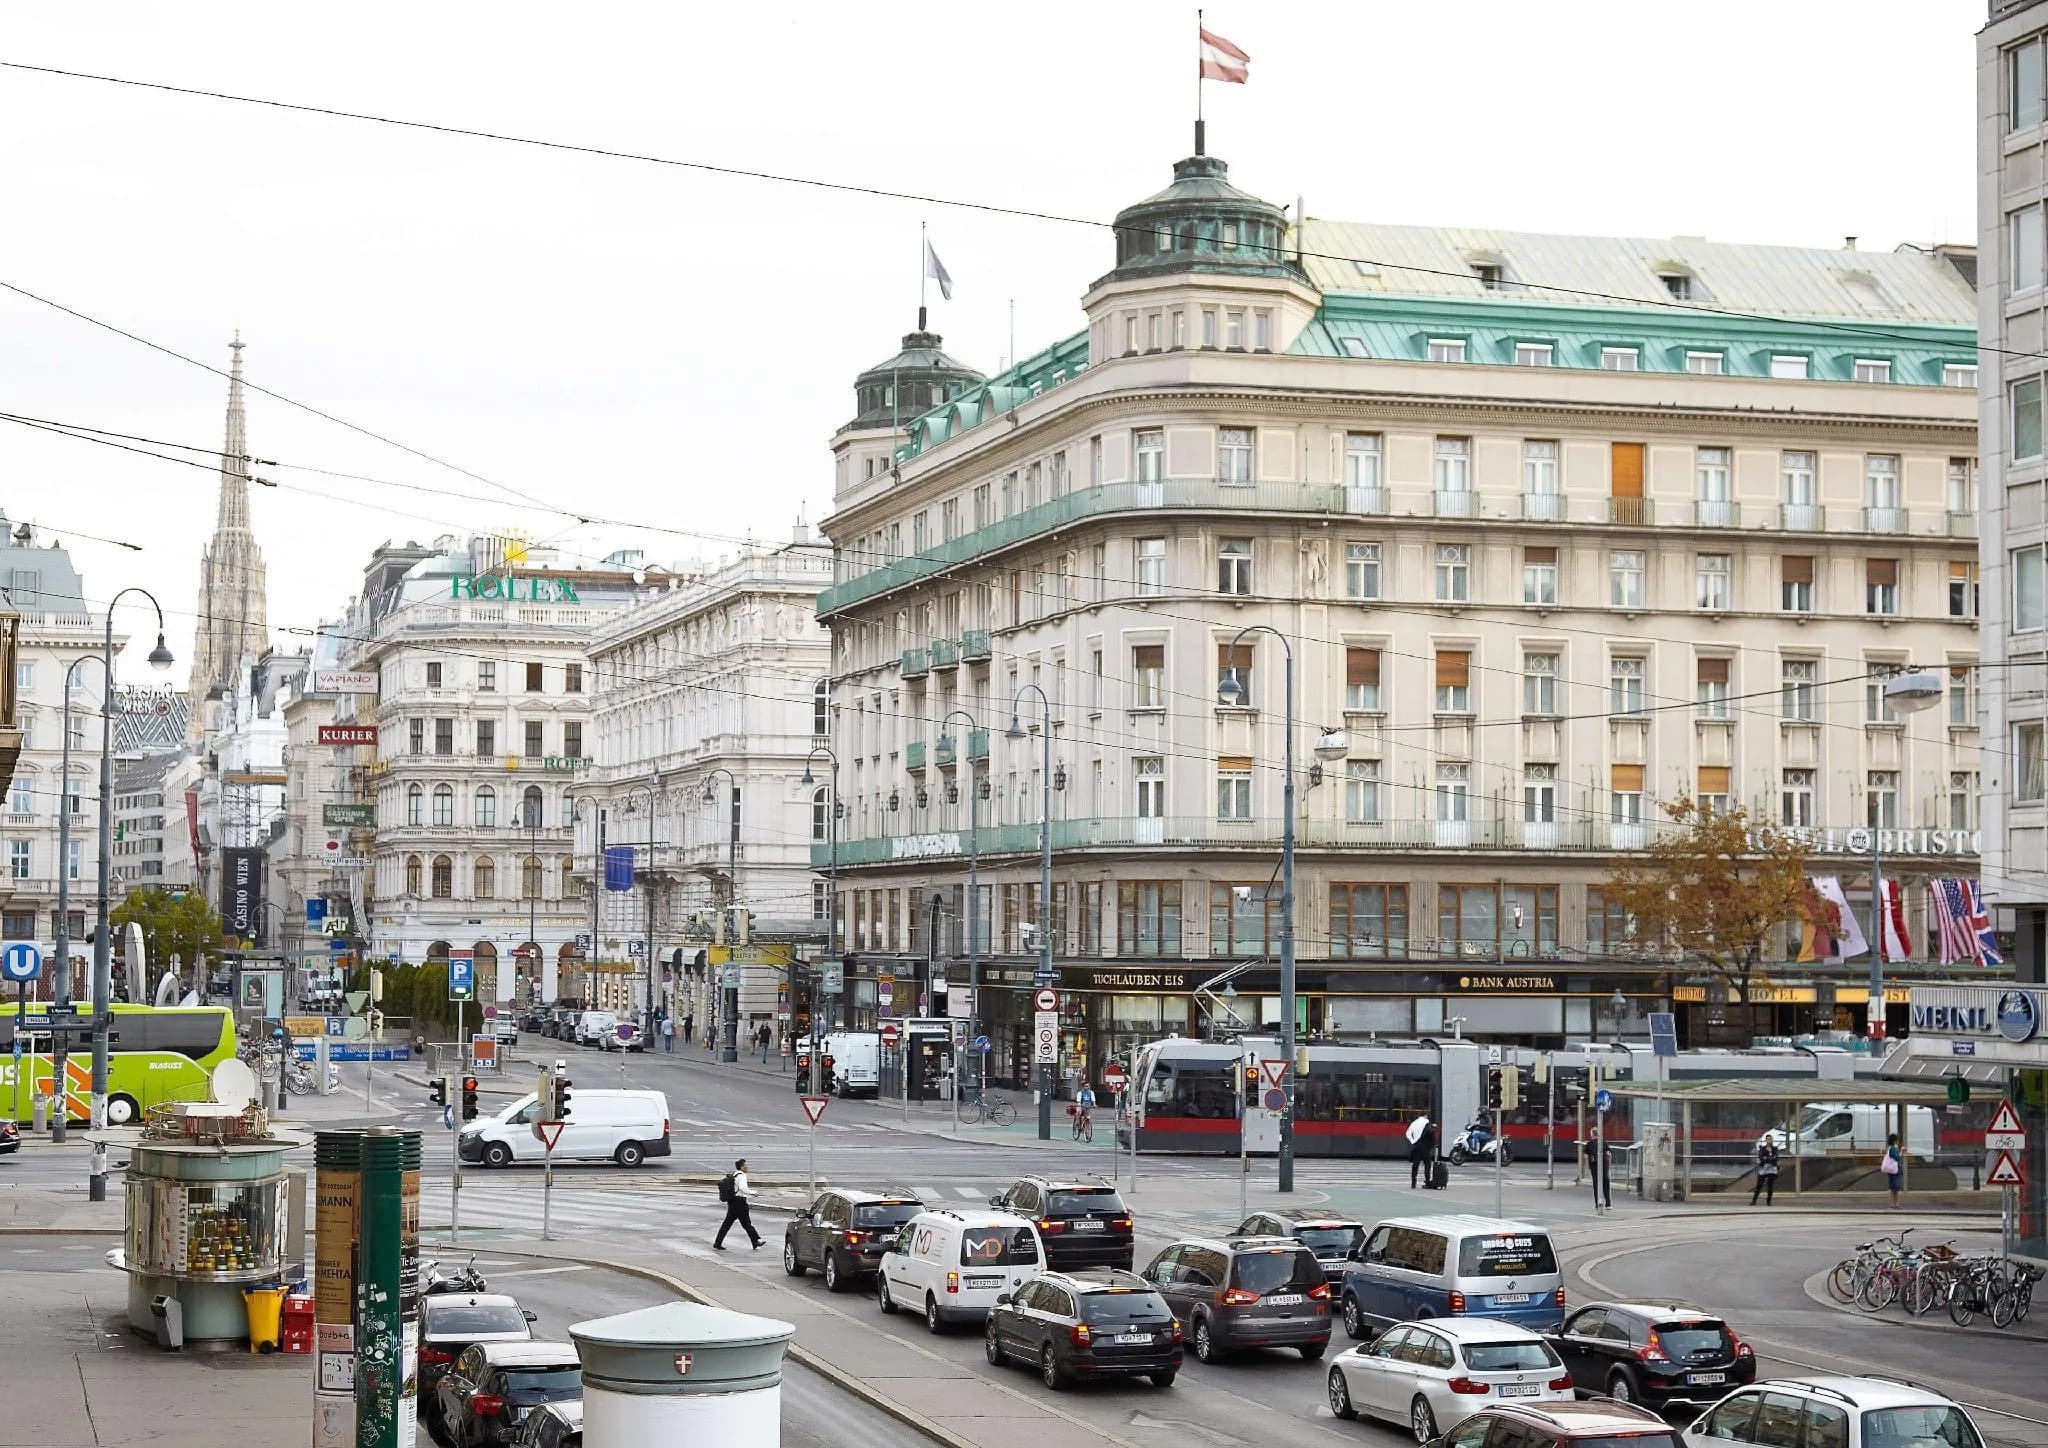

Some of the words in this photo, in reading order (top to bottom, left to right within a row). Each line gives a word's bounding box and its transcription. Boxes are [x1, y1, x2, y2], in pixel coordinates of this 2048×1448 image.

[450, 574, 580, 604] ROLEX
[320, 673, 371, 684] VAPIANO
[322, 730, 374, 741] KURIER
[236, 857, 248, 886] WIEN
[234, 889, 248, 930] CASINO
[9, 949, 35, 976] U
[454, 964, 467, 980] P
[1093, 974, 1162, 985] TUCHLAUBEN
[1164, 975, 1184, 986] EIS
[1472, 977, 1504, 988] BANK
[1506, 977, 1554, 988] AUSTRIA
[1749, 989, 1798, 1001] HOTEL
[1912, 1005, 1991, 1030] MEINL
[966, 1239, 1002, 1258] MD
[321, 1269, 352, 1280] MEHTA
